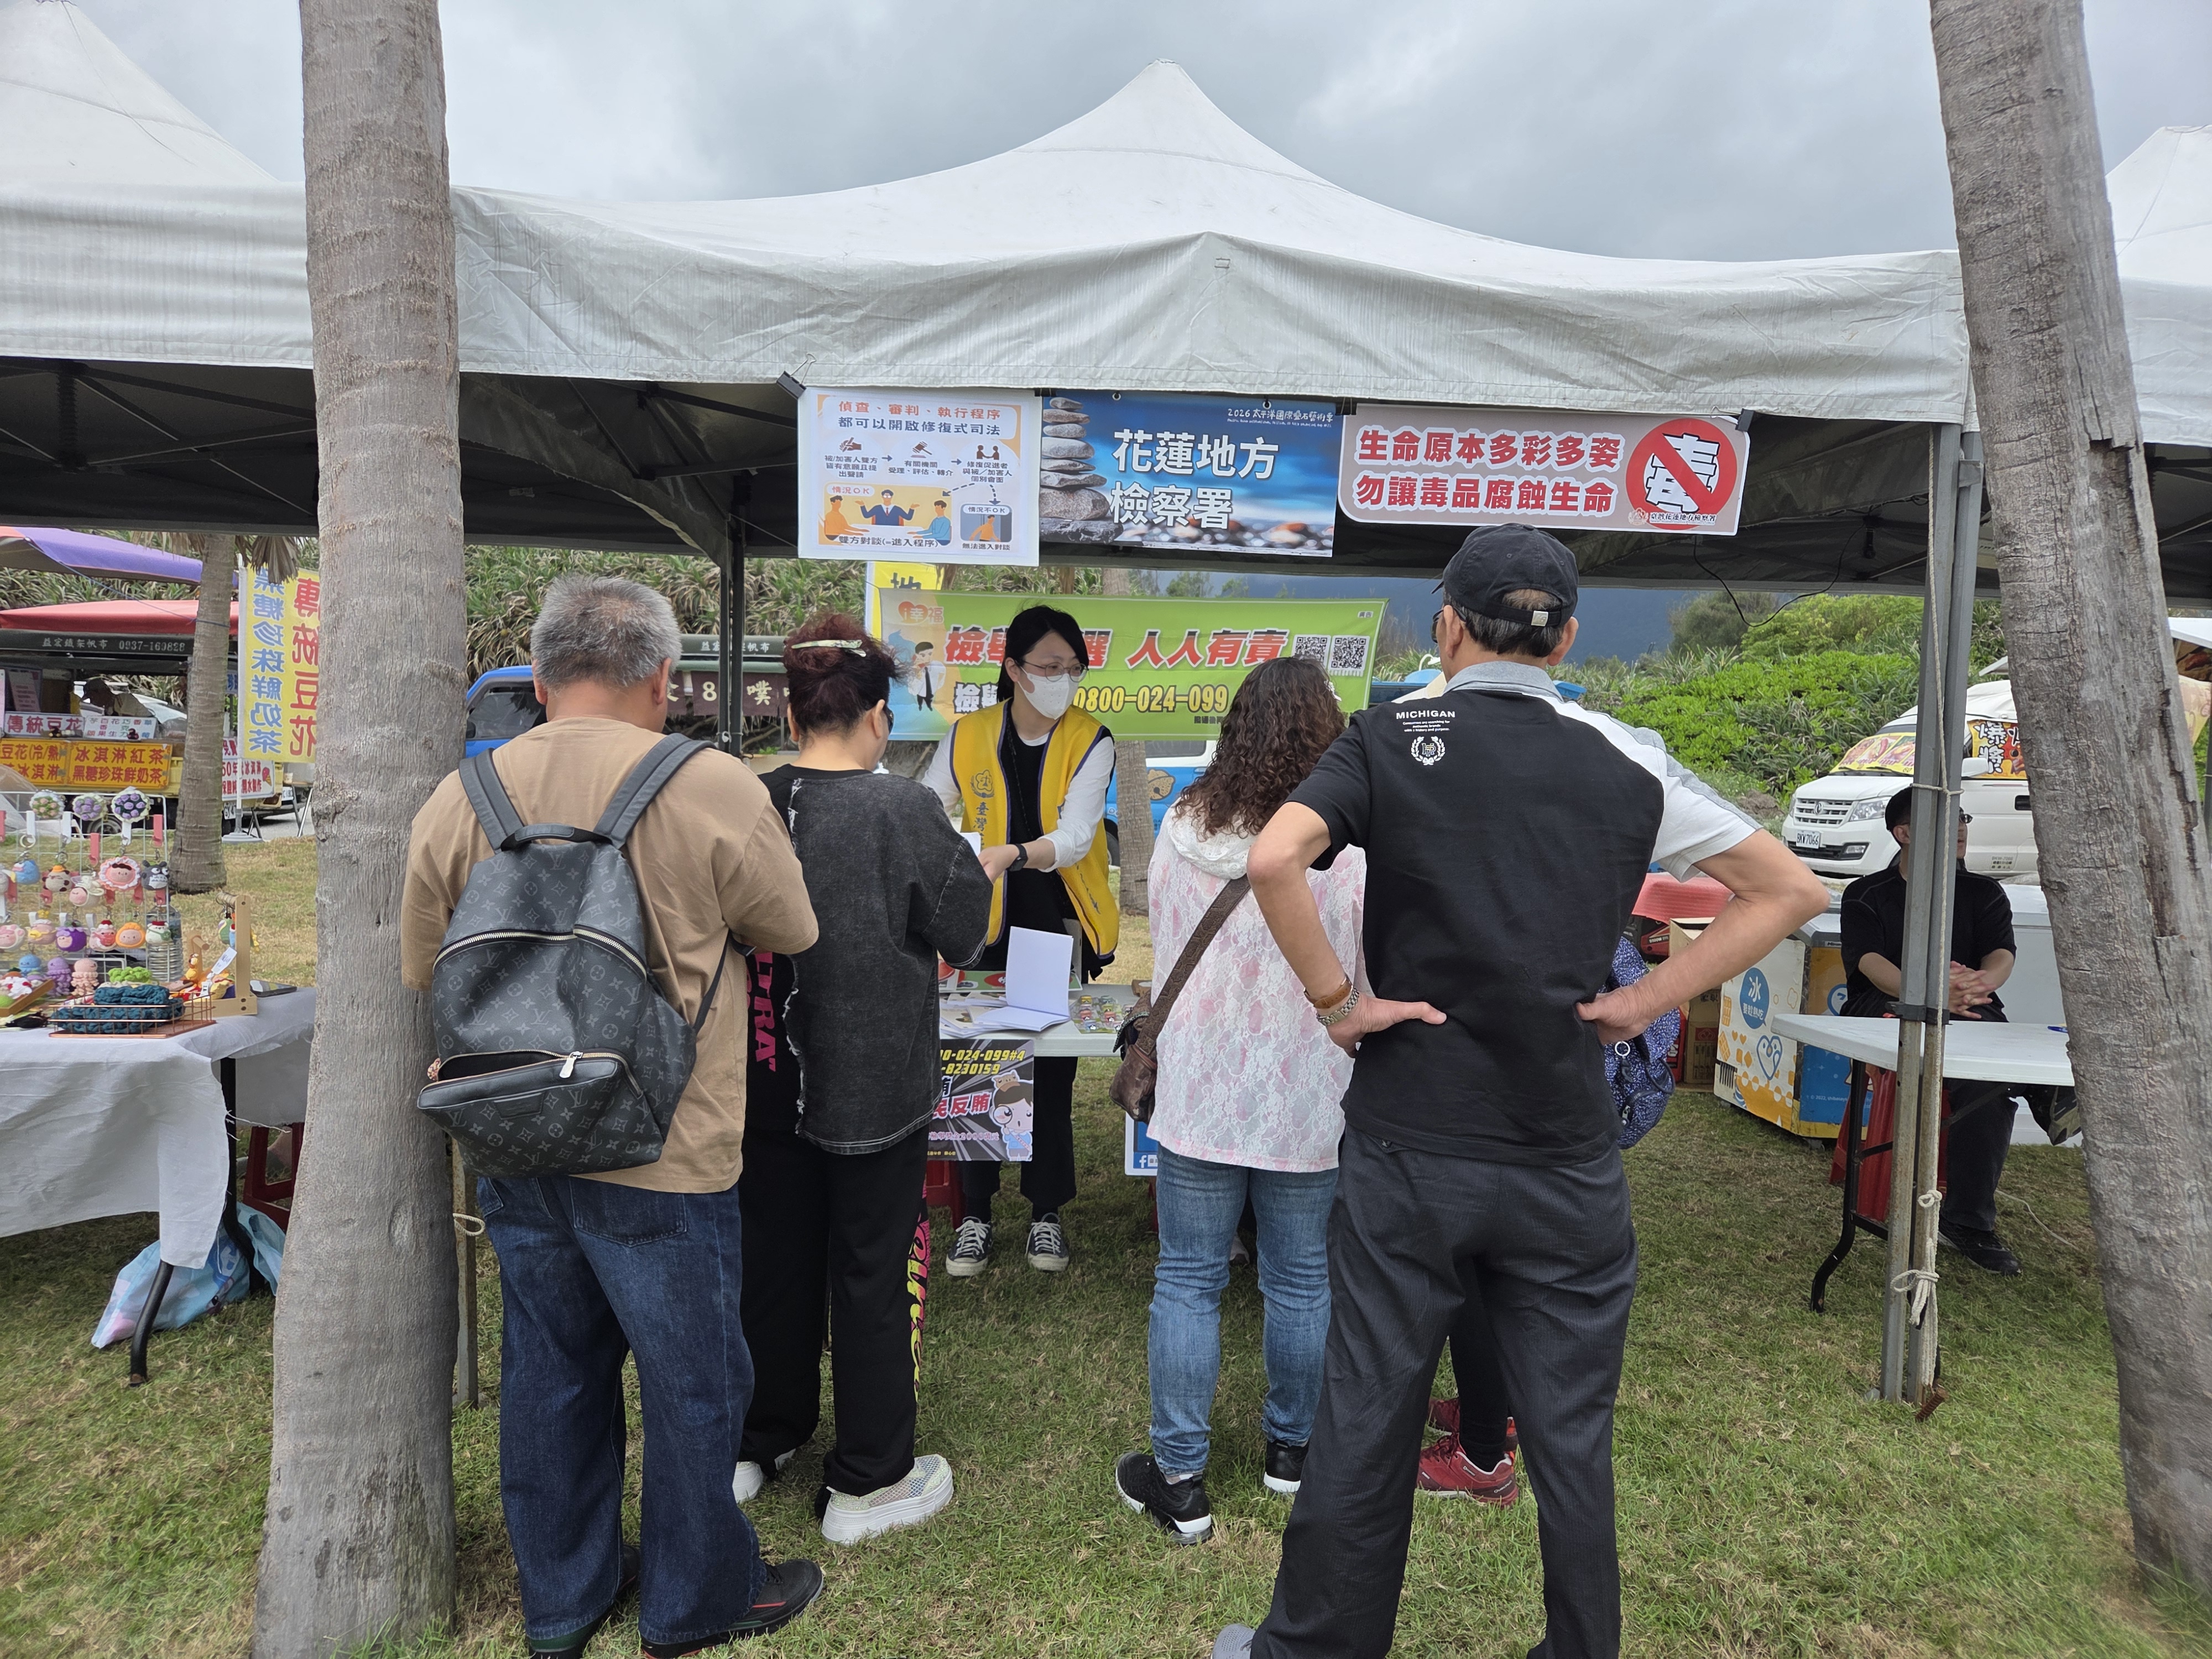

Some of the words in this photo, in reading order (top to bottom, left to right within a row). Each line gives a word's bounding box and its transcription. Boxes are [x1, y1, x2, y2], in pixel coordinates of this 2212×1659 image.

[838, 401, 1001, 420] 偵查、審判、執行程序
[1228, 409, 1250, 417] 2026
[838, 416, 1001, 436] 都可以開啟修復式司法
[1112, 429, 1279, 479] 花蓮地方
[1358, 430, 1621, 468] 生命原本多彩多姿
[1357, 475, 1614, 513] 勿讓毒品腐蝕生命
[1110, 482, 1233, 529] 檢察署
[1127, 629, 1287, 667] 人人有責
[1396, 710, 1455, 719] MICHIGAN
[75, 747, 164, 765] 冰淇淋紅茶
[3, 763, 60, 780] 冰淇淋
[72, 765, 163, 784] 黑糖珍珠鮮奶茶
[1748, 976, 1761, 1002] 冰
[941, 1050, 1026, 1061] 0-024-099#4
